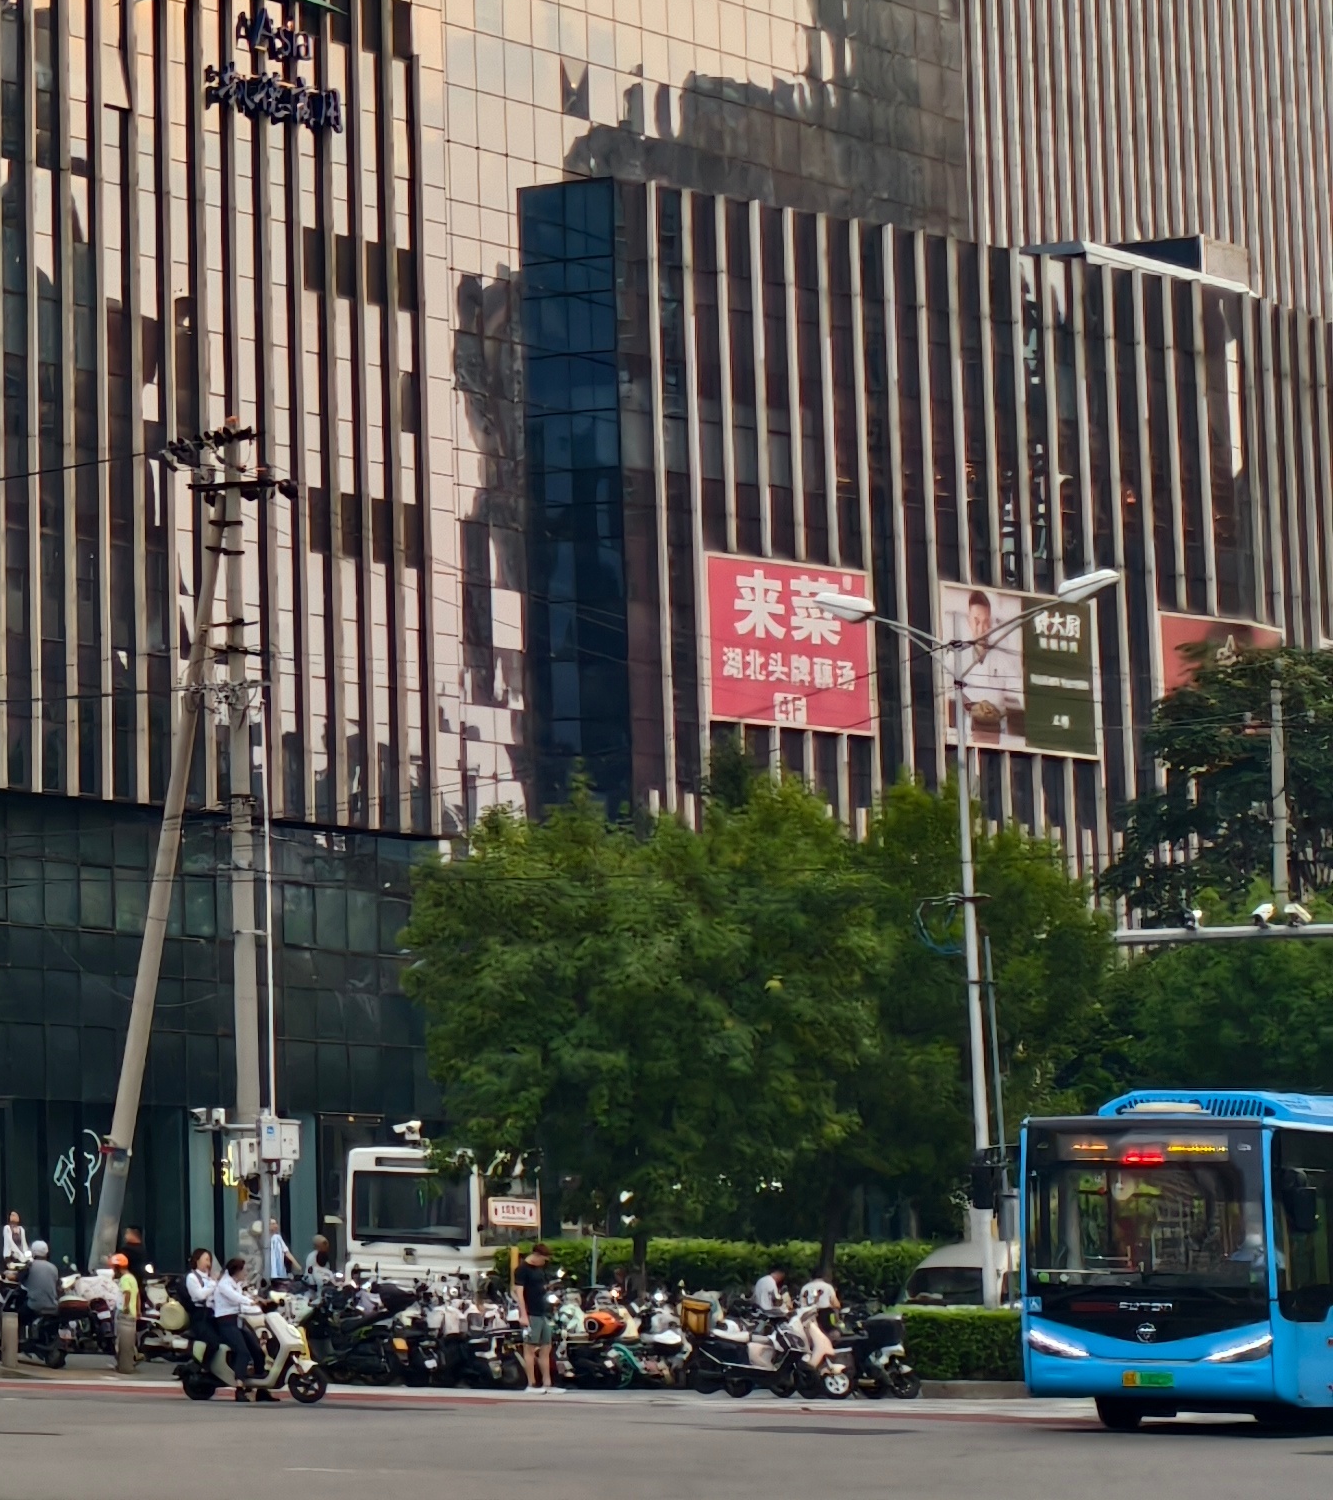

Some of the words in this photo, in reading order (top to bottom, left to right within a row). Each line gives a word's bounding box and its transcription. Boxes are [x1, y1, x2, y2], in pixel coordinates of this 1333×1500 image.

[253, 8, 312, 60] Asia
[734, 569, 841, 645] 来菜
[779, 697, 805, 721] 4F
